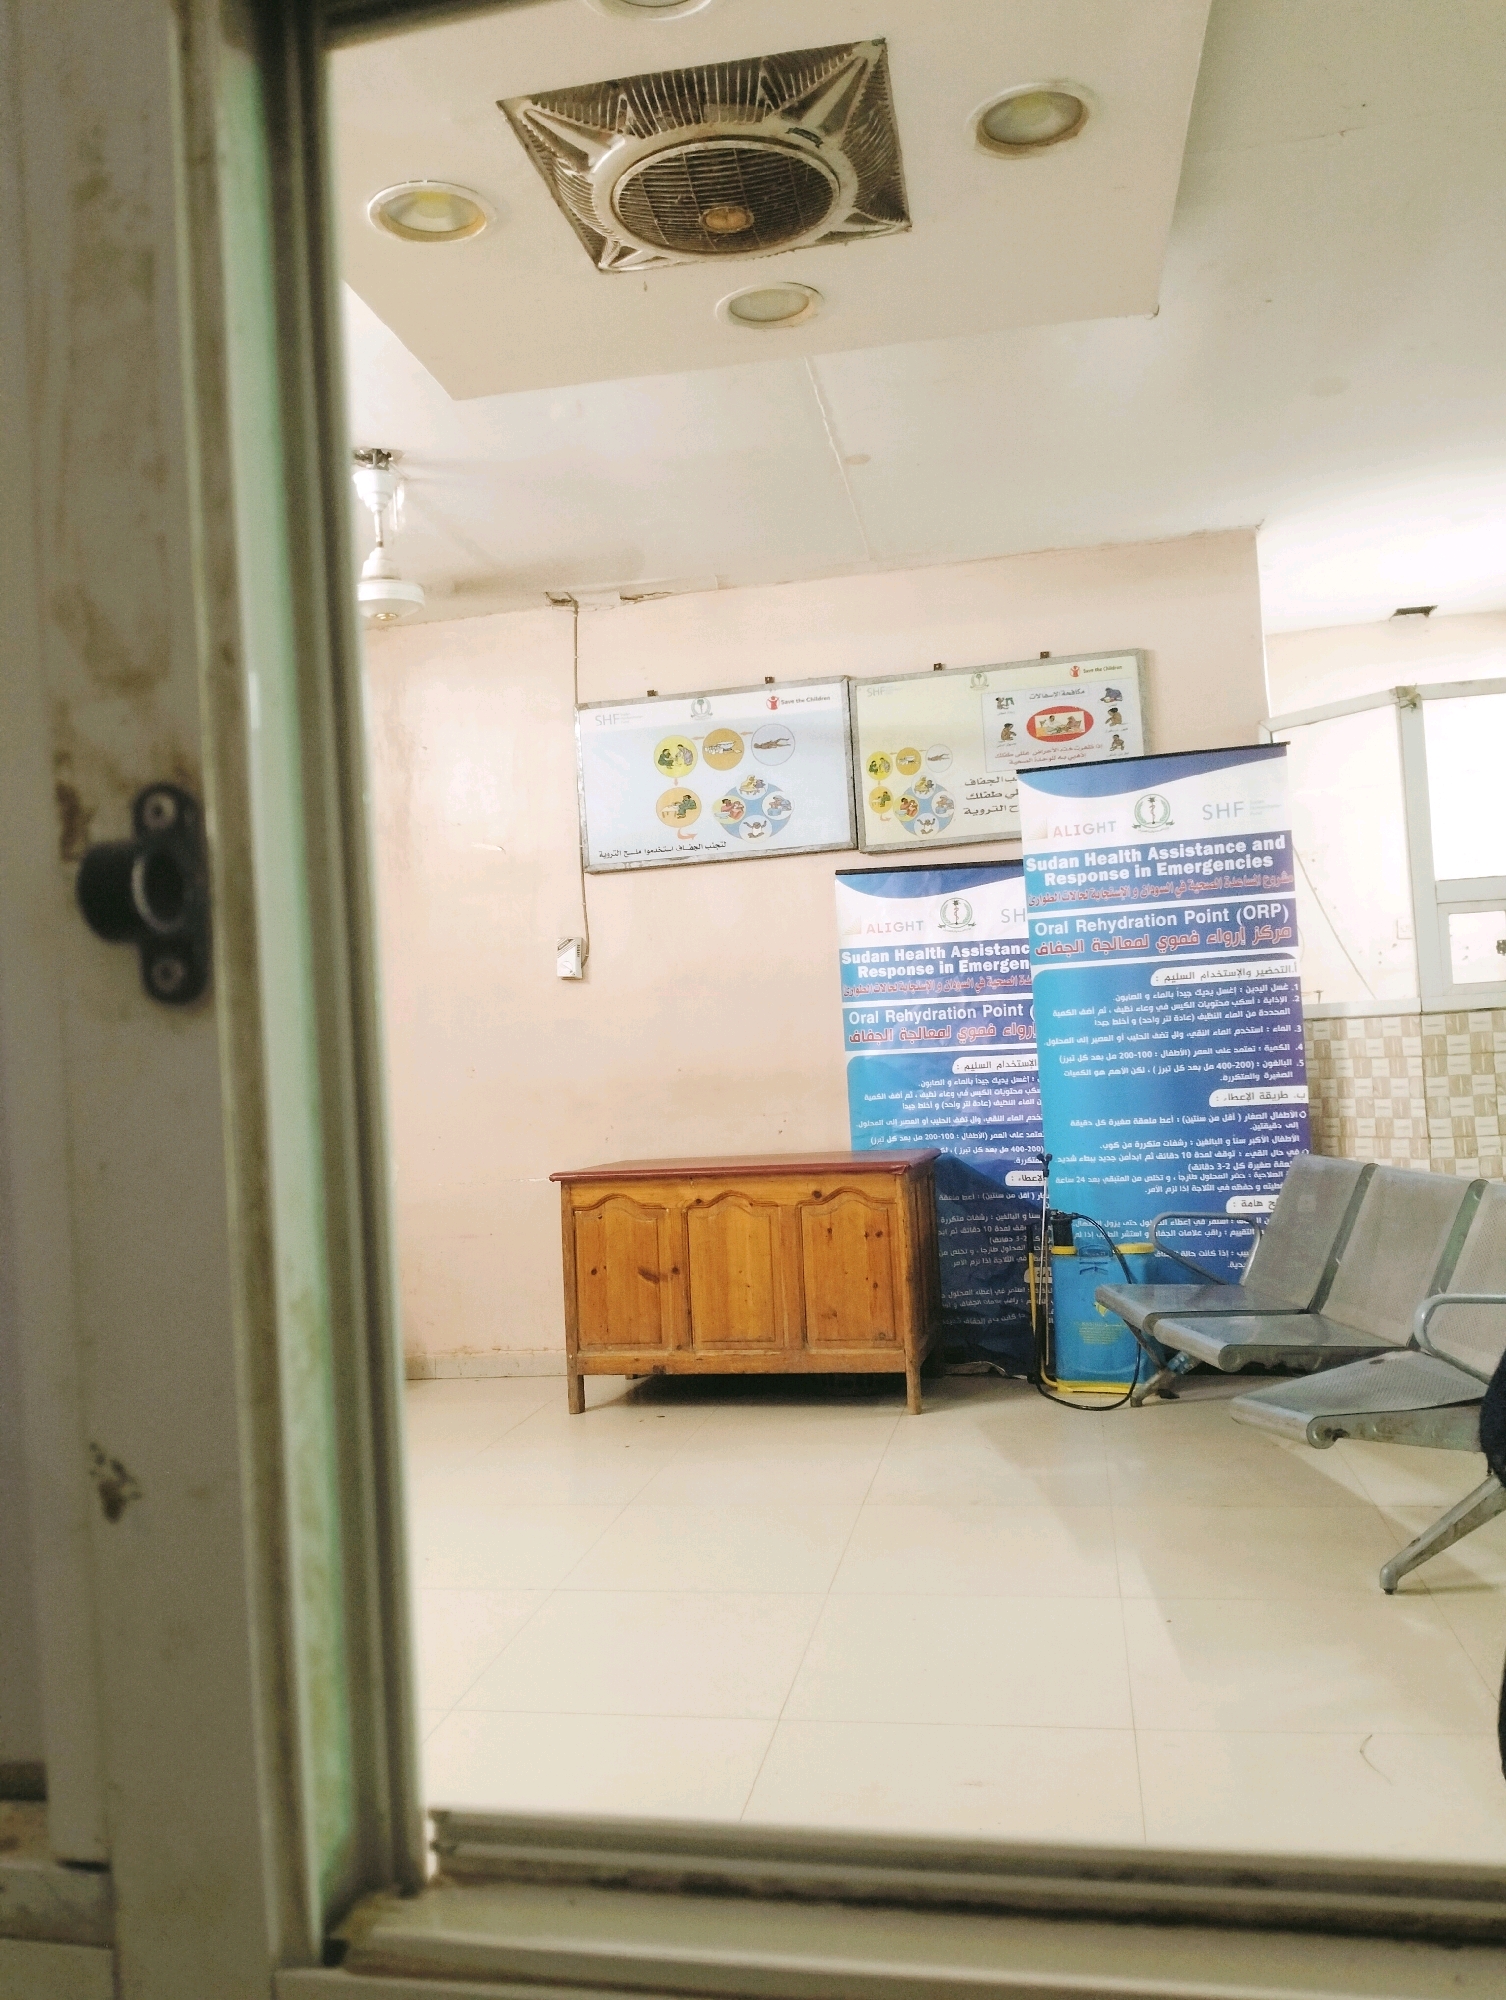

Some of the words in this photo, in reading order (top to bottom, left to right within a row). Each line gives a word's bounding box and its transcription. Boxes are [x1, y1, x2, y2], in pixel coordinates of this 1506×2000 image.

[595, 713, 620, 726] SHF
[965, 776, 1003, 786] الجفاف
[966, 791, 1002, 800] طفلك
[963, 804, 1007, 816] التروية
[1202, 801, 1244, 820] SHF
[1053, 820, 1117, 838] ALIGHT
[675, 843, 703, 852] الجفاف
[705, 841, 726, 851] لتجنب
[599, 850, 621, 858] التروية
[1026, 855, 1079, 872] Sudan
[1084, 849, 1142, 867] Health
[1147, 841, 1246, 860] Assistance
[1252, 835, 1286, 851] and
[1044, 868, 1130, 886] Response
[1134, 864, 1151, 878] in
[1156, 854, 1273, 876] Emergencies
[1141, 880, 1174, 898] السودان
[1174, 880, 1187, 898] في
[1188, 877, 1223, 893] الصحية
[1062, 890, 1089, 901] لحالات
[1001, 908, 1026, 923] SH
[1035, 921, 1068, 936] Oral
[1076, 914, 1177, 934] Rehydration
[1185, 908, 1230, 924] Point
[1236, 903, 1289, 925] (ORP)
[866, 920, 924, 934] ALIGHT
[1206, 925, 1245, 947] إرواء
[1252, 925, 1292, 945] مركز
[1091, 933, 1150, 955] لمعالجة
[1156, 930, 1200, 953] فموي
[1035, 939, 1085, 957] الجفاف
[841, 950, 890, 965] Sudan
[894, 947, 946, 961] Health
[951, 943, 1029, 959] Assistanc
[857, 963, 935, 979] Response
[939, 960, 954, 974] in
[1164, 971, 1195, 983] السليم
[944, 976, 974, 992] السودان
[974, 976, 986, 993] في
[987, 975, 1018, 990] الصحية
[1270, 983, 1289, 992] غسل
[1194, 988, 1214, 998] يديك
[1245, 984, 1268, 994] اليدين
[1152, 991, 1174, 1000] بالماء
[1135, 1004, 1154, 1013] وعاء
[1155, 1003, 1169, 1012] في
[1171, 1001, 1195, 1011] الكيس
[1197, 999, 1230, 1009] محتويات
[849, 1010, 879, 1025] Oral
[886, 1006, 977, 1025] Rehydration
[982, 1003, 1024, 1018] Point
[1052, 1009, 1077, 1018] الكمية
[1097, 1006, 1107, 1016] ثم
[1113, 1005, 1134, 1014] نظيف
[1224, 1010, 1243, 1019] الماء
[1245, 1010, 1256, 1018] من
[1258, 1007, 1291, 1017] المحددة
[1161, 1015, 1172, 1025] لتر
[1196, 1011, 1222, 1021] النظيف
[957, 1023, 997, 1044] فموي
[1212, 1028, 1231, 1037] الماء
[1233, 1025, 1264, 1036] استخدم
[1272, 1024, 1292, 1033] الماء
[849, 1028, 893, 1045] الجفاف
[900, 1025, 952, 1045] لمعالجة
[1091, 1034, 1114, 1045] العصير
[1116, 1033, 1125, 1043] أو
[1126, 1032, 1150, 1042] الحليب
[1151, 1031, 1169, 1040] تضف
[1192, 1047, 1213, 1058] العمر
[1233, 1045, 1256, 1054] تعتمد
[1263, 1043, 1291, 1053] الكمية
[1077, 1053, 1089, 1063] كل
[1090, 1054, 1104, 1062] بعد
[1105, 1052, 1117, 1062] مل
[964, 1061, 992, 1072] السليم
[991, 1077, 1009, 1086] يديك
[1259, 1090, 1289, 1102] طريقة
[1132, 1117, 1157, 1125] ملعقة
[1208, 1114, 1220, 1123] من
[1243, 1111, 1268, 1123] الصغار
[1069, 1119, 1093, 1128] دقيقة
[1094, 1118, 1107, 1127] كل
[1108, 1118, 1131, 1127] صغيرة
[1098, 1154, 1117, 1163] جديد
[1144, 1151, 1154, 1162] ثم
[1155, 1152, 1180, 1161] دقائق
[1181, 1151, 1192, 1159] 10
[1194, 1150, 1213, 1159] لمدة
[1214, 1151, 1236, 1160] توقف
[1270, 1149, 1285, 1158] حال
[1286, 1149, 1300, 1158] في
